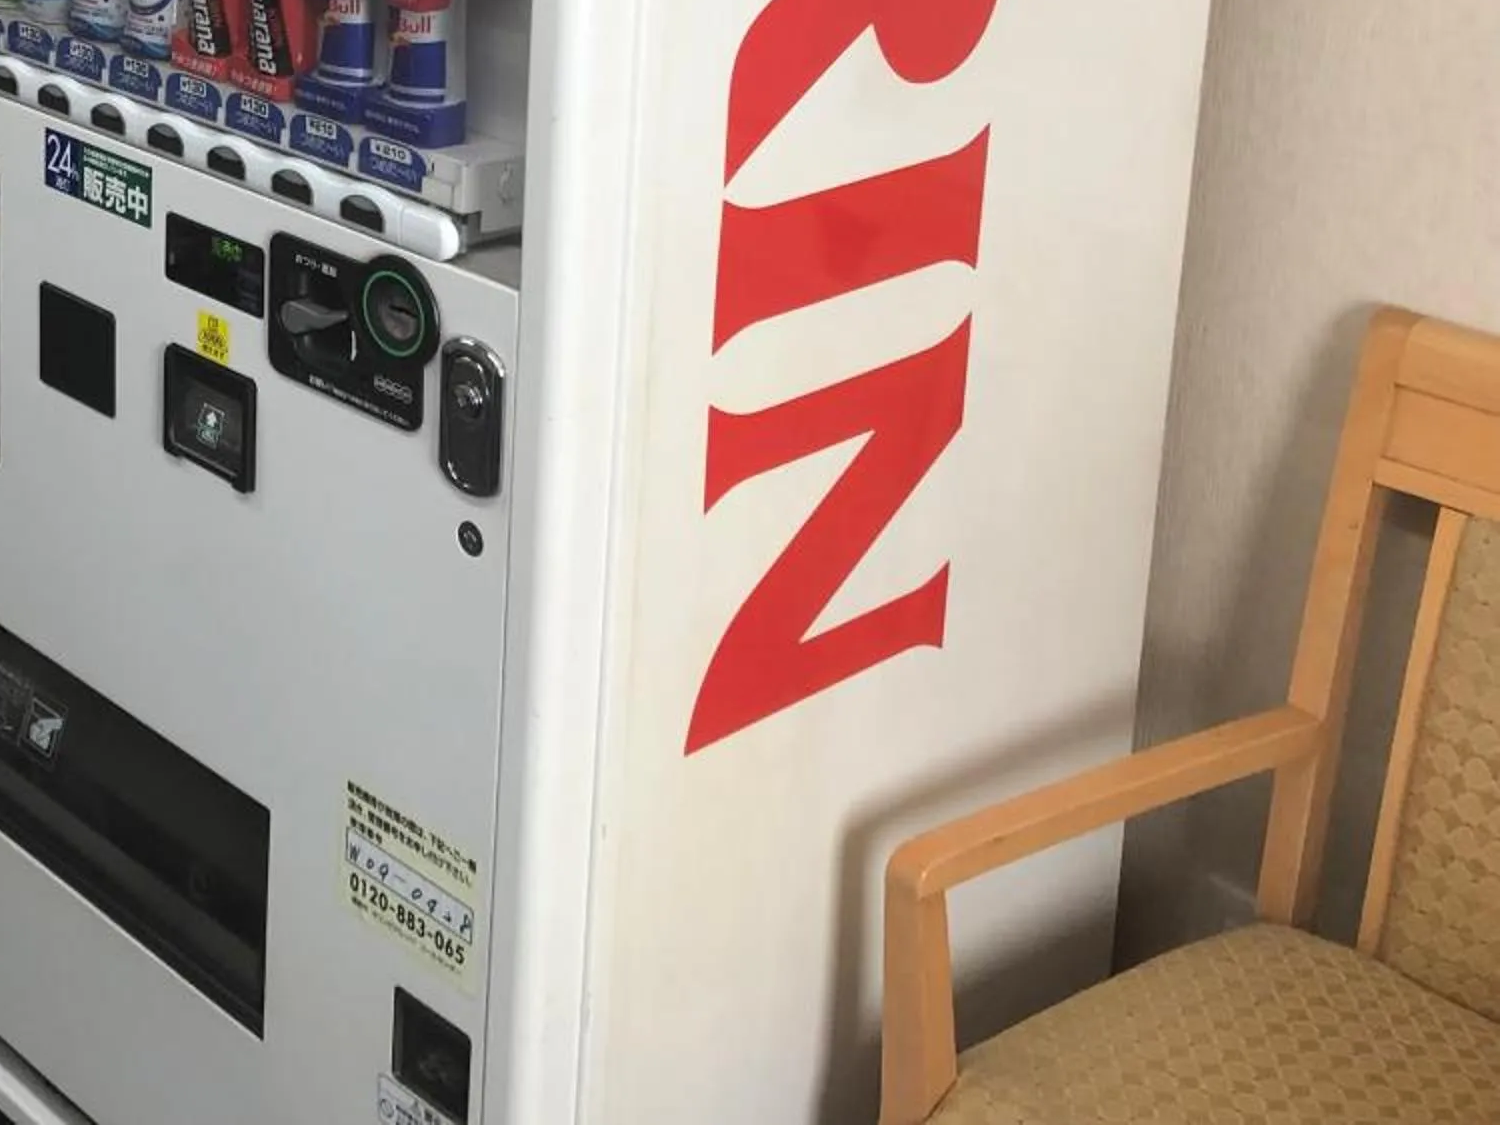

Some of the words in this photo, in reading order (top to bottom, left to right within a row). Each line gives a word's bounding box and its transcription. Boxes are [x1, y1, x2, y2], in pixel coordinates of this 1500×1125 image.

[397, 13, 432, 35] Bull
[83, 166, 149, 221] 販売中
[349, 871, 466, 966] 0120-883-065
